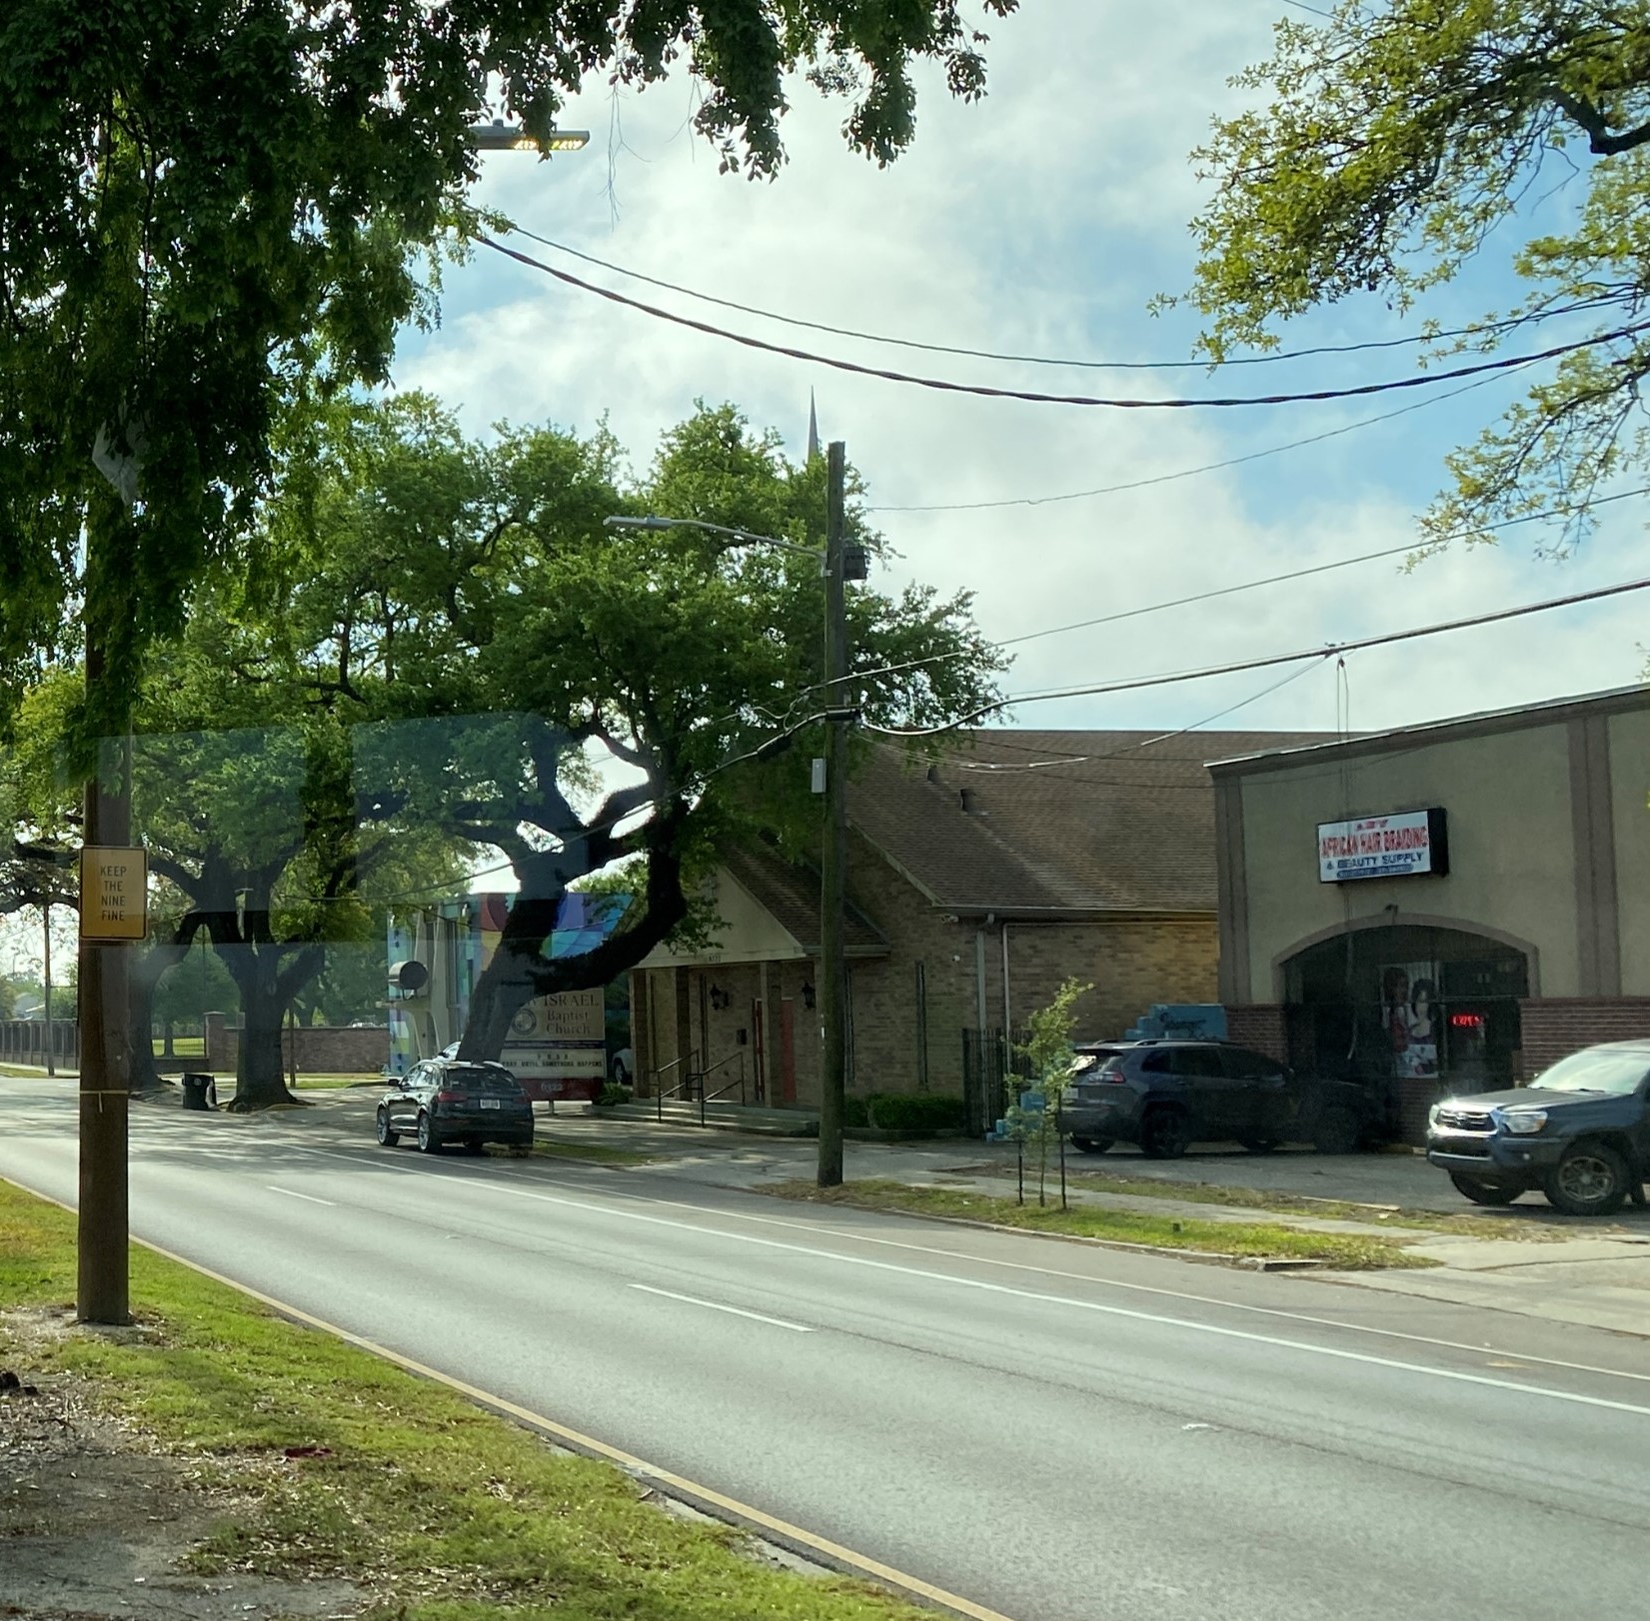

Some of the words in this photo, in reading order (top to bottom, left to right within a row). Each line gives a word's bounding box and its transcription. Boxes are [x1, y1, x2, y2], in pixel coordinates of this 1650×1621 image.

[1337, 856, 1377, 869] BEAUTY
[1382, 852, 1423, 865] SUPPLY
[100, 865, 127, 877] KEEP
[104, 880, 123, 892] THE
[101, 895, 126, 907] NINE
[101, 910, 125, 922] FINE
[543, 994, 600, 1007] ISRAEL
[547, 1010, 589, 1023] Baptist
[546, 1023, 591, 1035] Church
